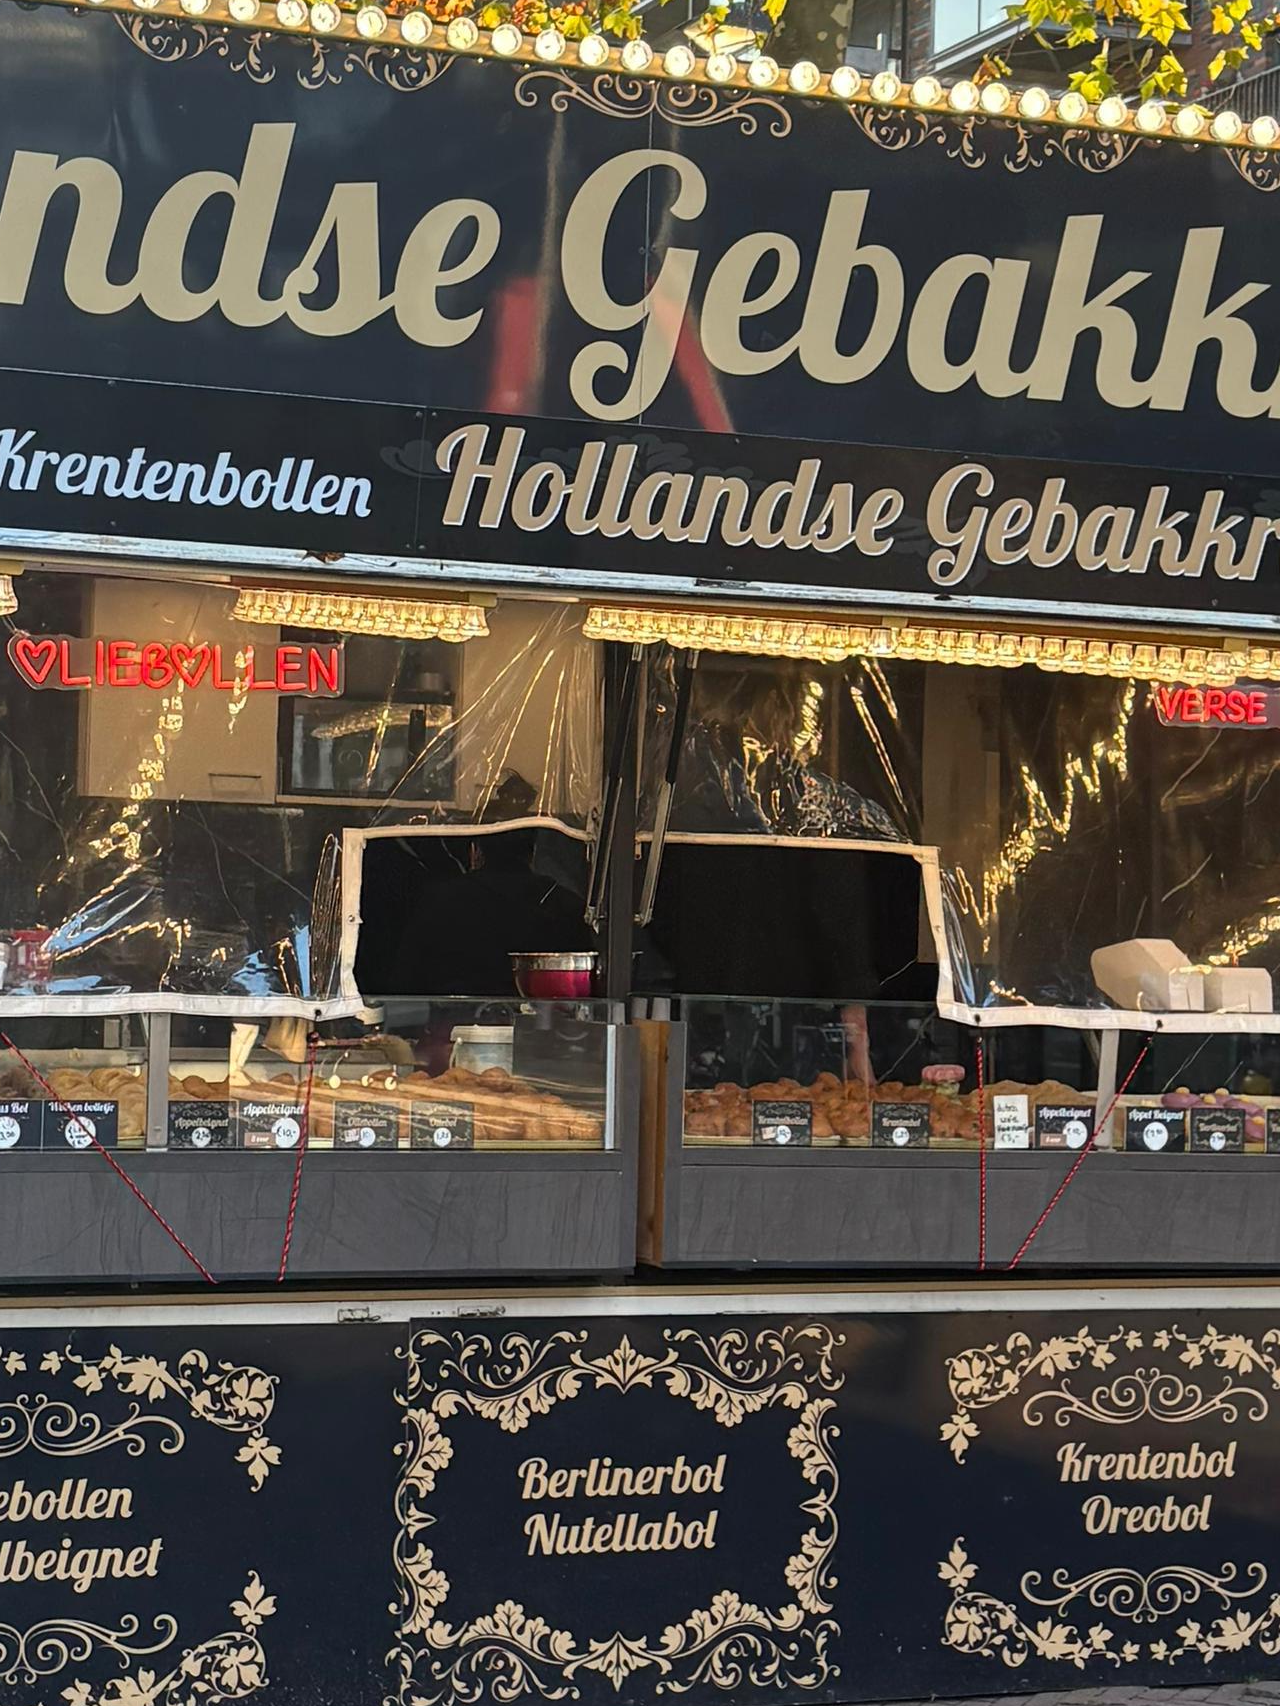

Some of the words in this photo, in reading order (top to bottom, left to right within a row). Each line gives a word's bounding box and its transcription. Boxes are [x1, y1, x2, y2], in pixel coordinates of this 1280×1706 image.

[435, 423, 905, 556] Hollandse
[1161, 687, 1268, 724] VERSE
[517, 1454, 727, 1500] Berlinerbol
[1056, 1440, 1238, 1483] Krentenbol
[524, 1509, 719, 1556] Nutellabol
[1081, 1494, 1213, 1535] Oreobol
